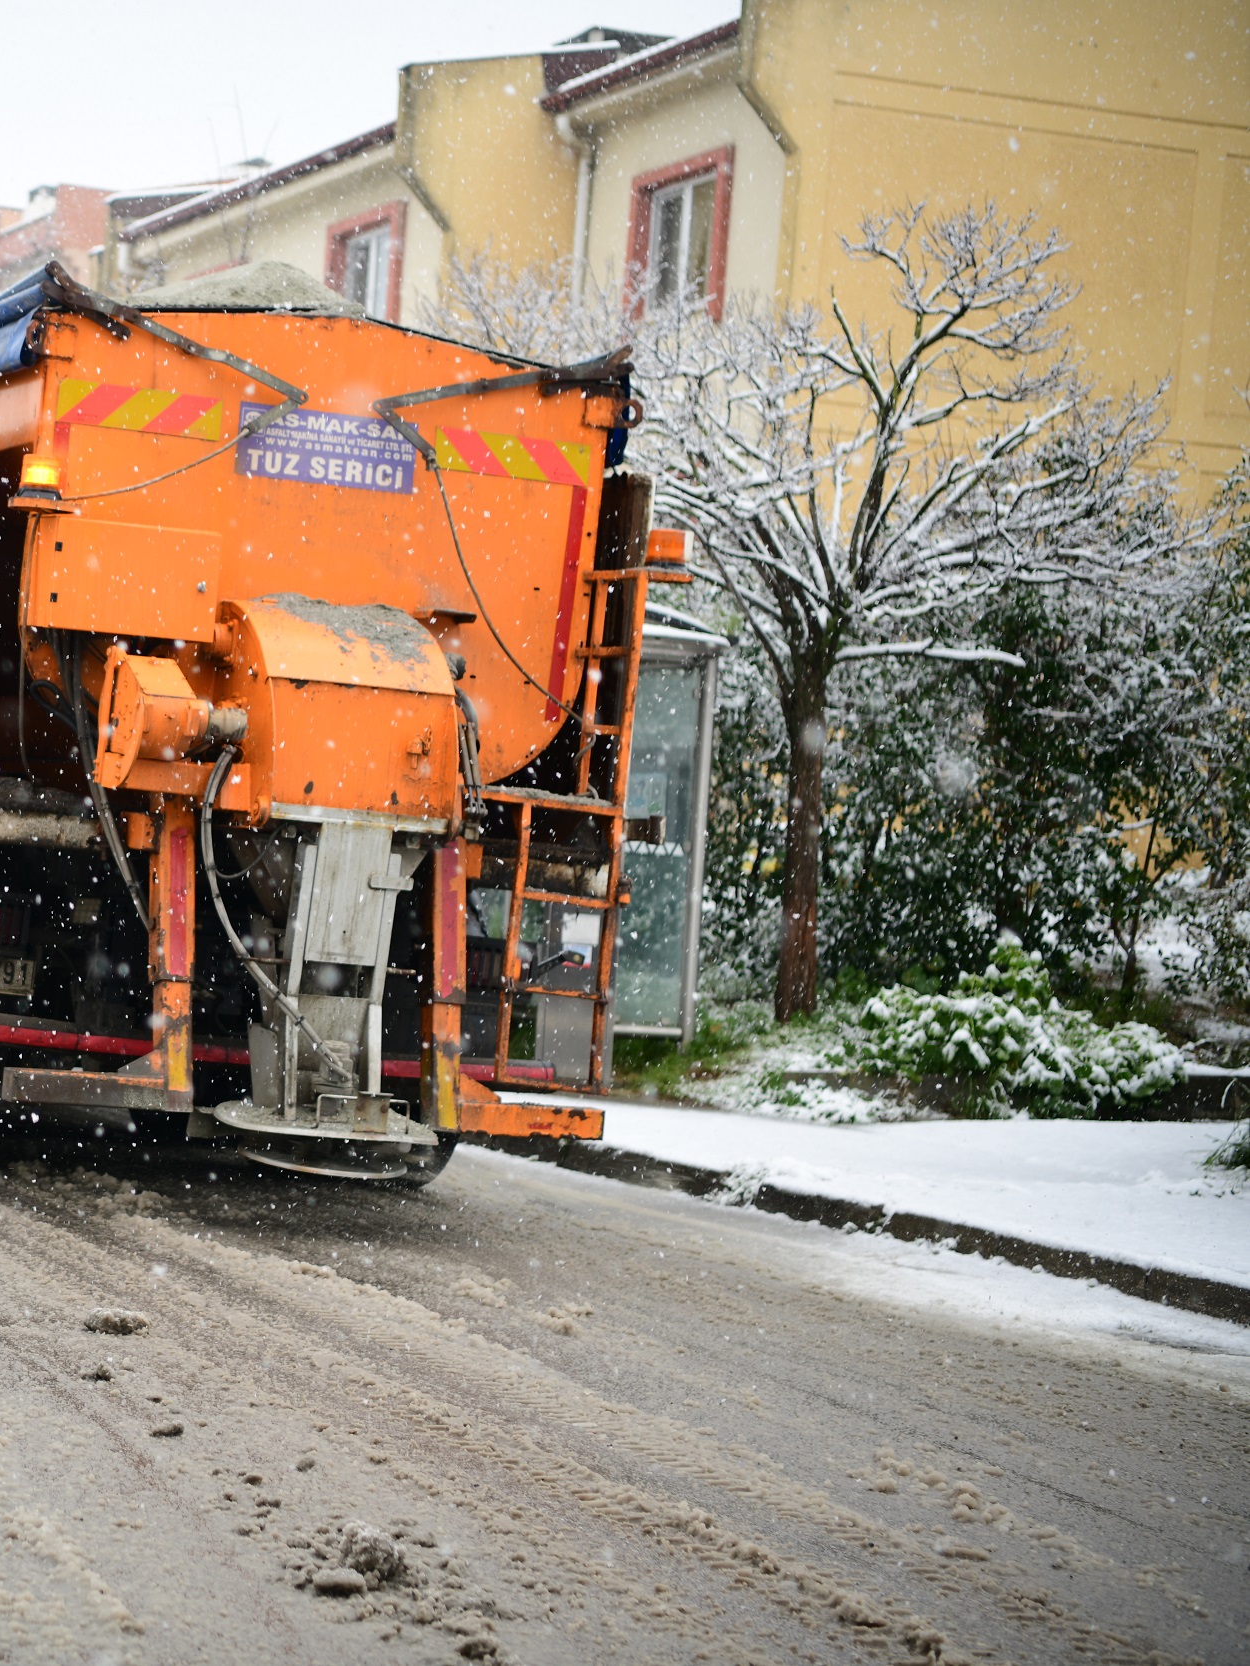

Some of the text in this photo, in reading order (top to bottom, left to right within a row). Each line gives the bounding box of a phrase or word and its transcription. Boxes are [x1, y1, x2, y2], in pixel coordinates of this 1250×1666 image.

[266, 427, 290, 438] ASFALT
[385, 441, 400, 451] LTD.
[247, 448, 300, 476] TUZ
